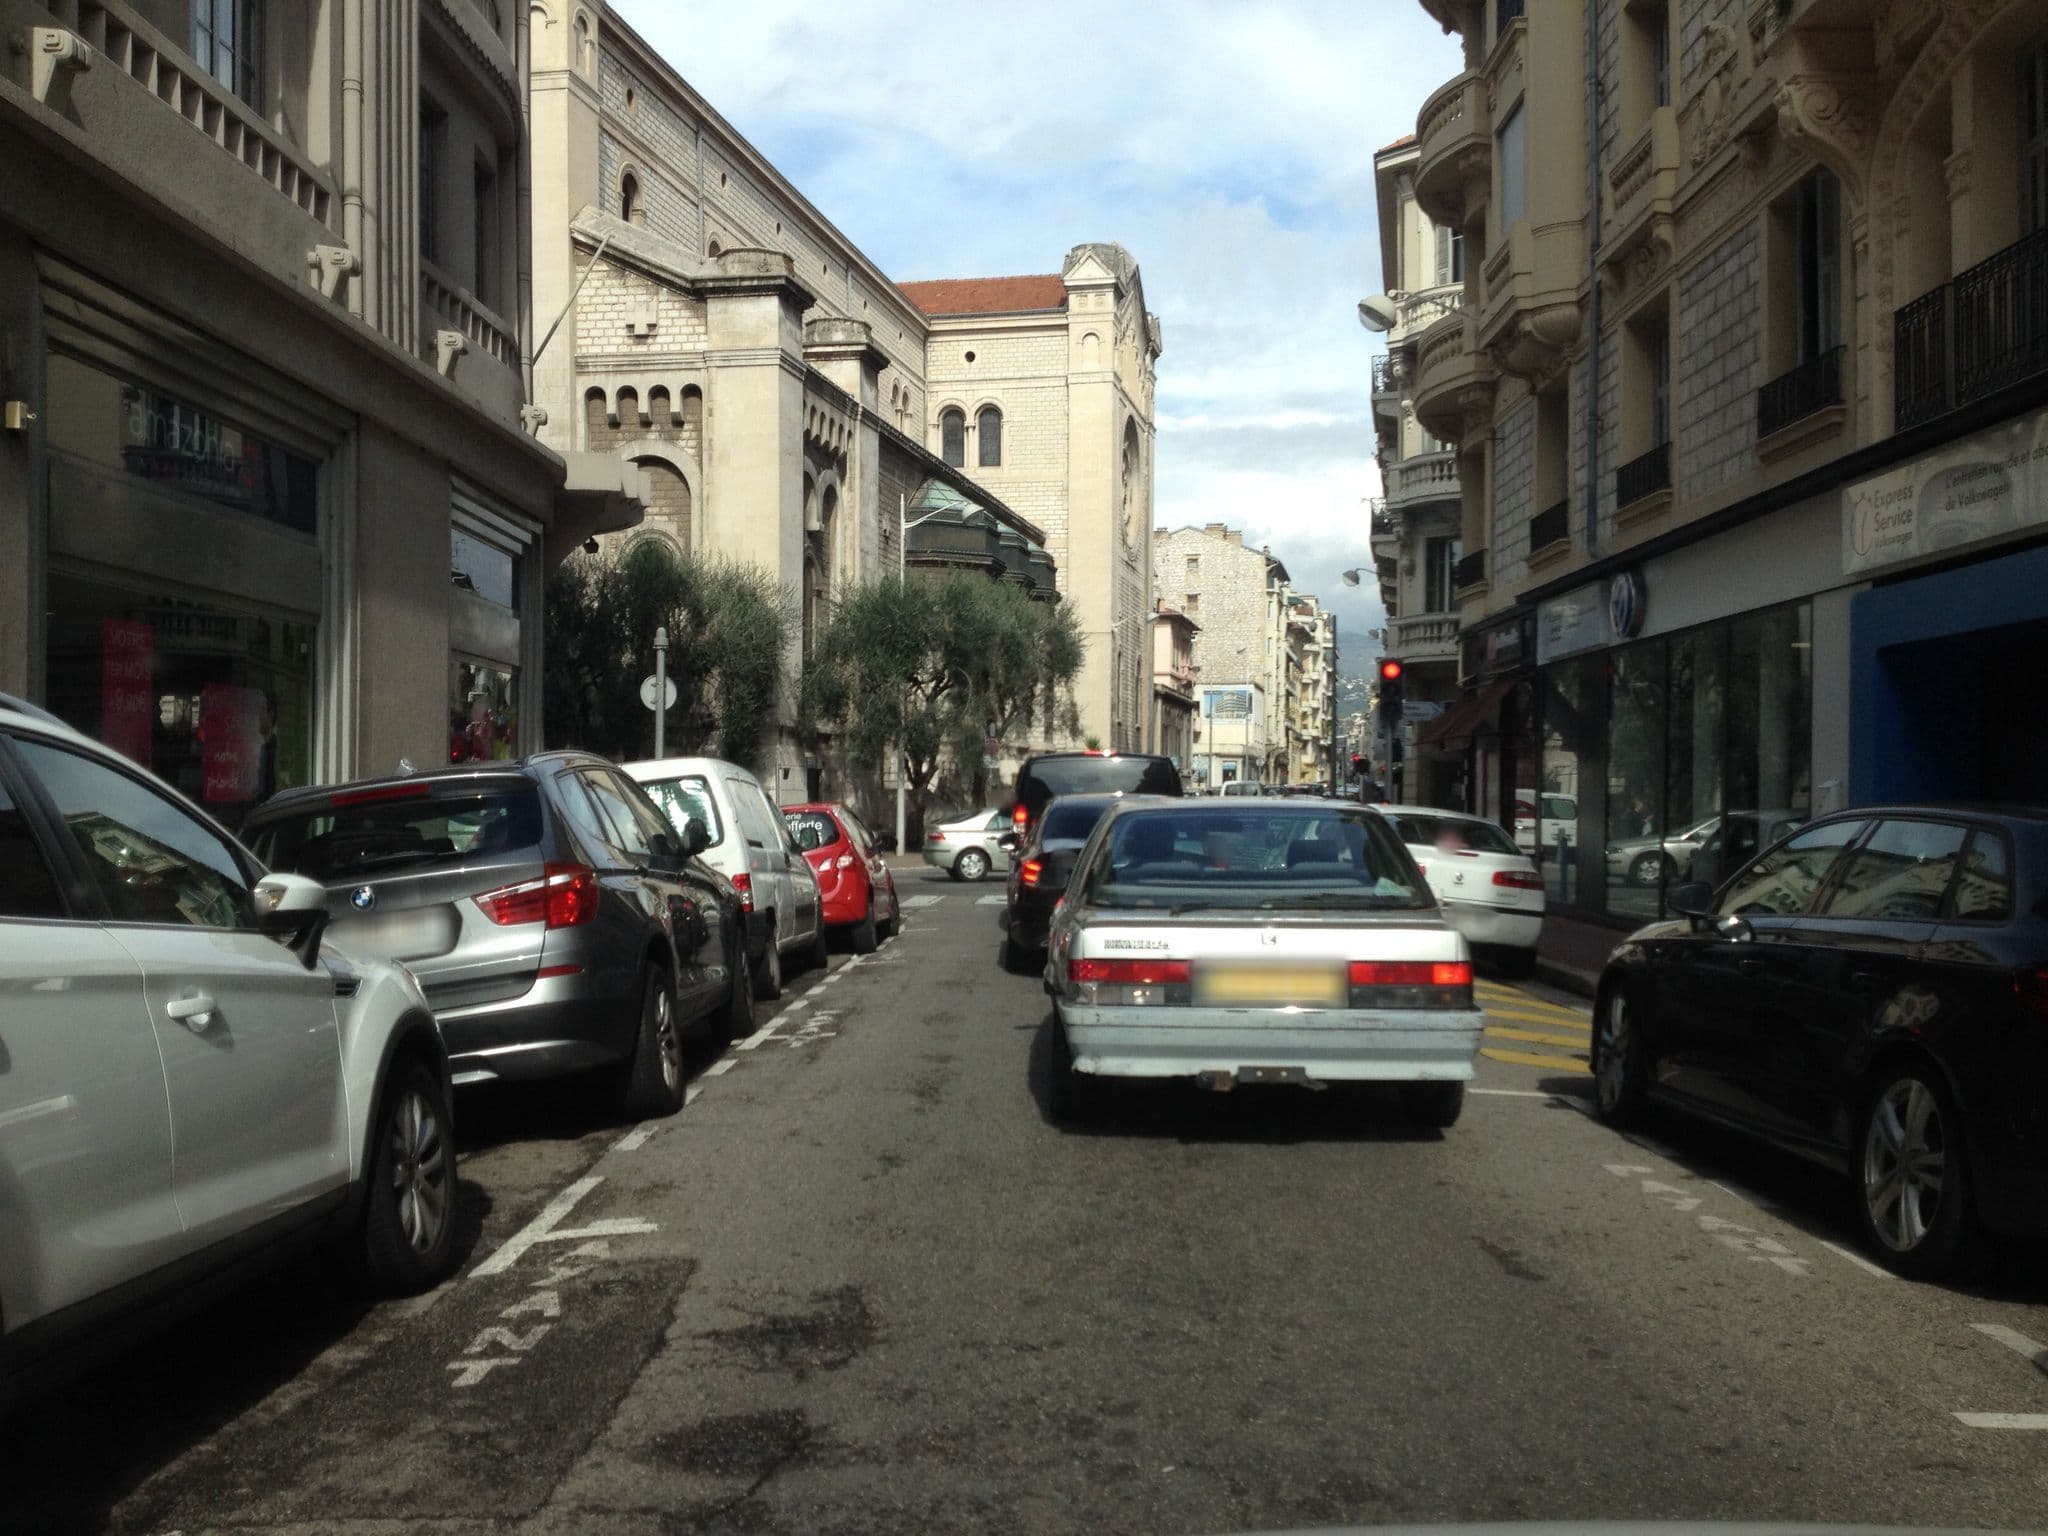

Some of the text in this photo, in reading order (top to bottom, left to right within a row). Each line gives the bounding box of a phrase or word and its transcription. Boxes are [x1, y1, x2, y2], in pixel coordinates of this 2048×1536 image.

[1873, 485, 1913, 509] Express
[1873, 509, 1913, 532] Service
[785, 812, 802, 821] erie
